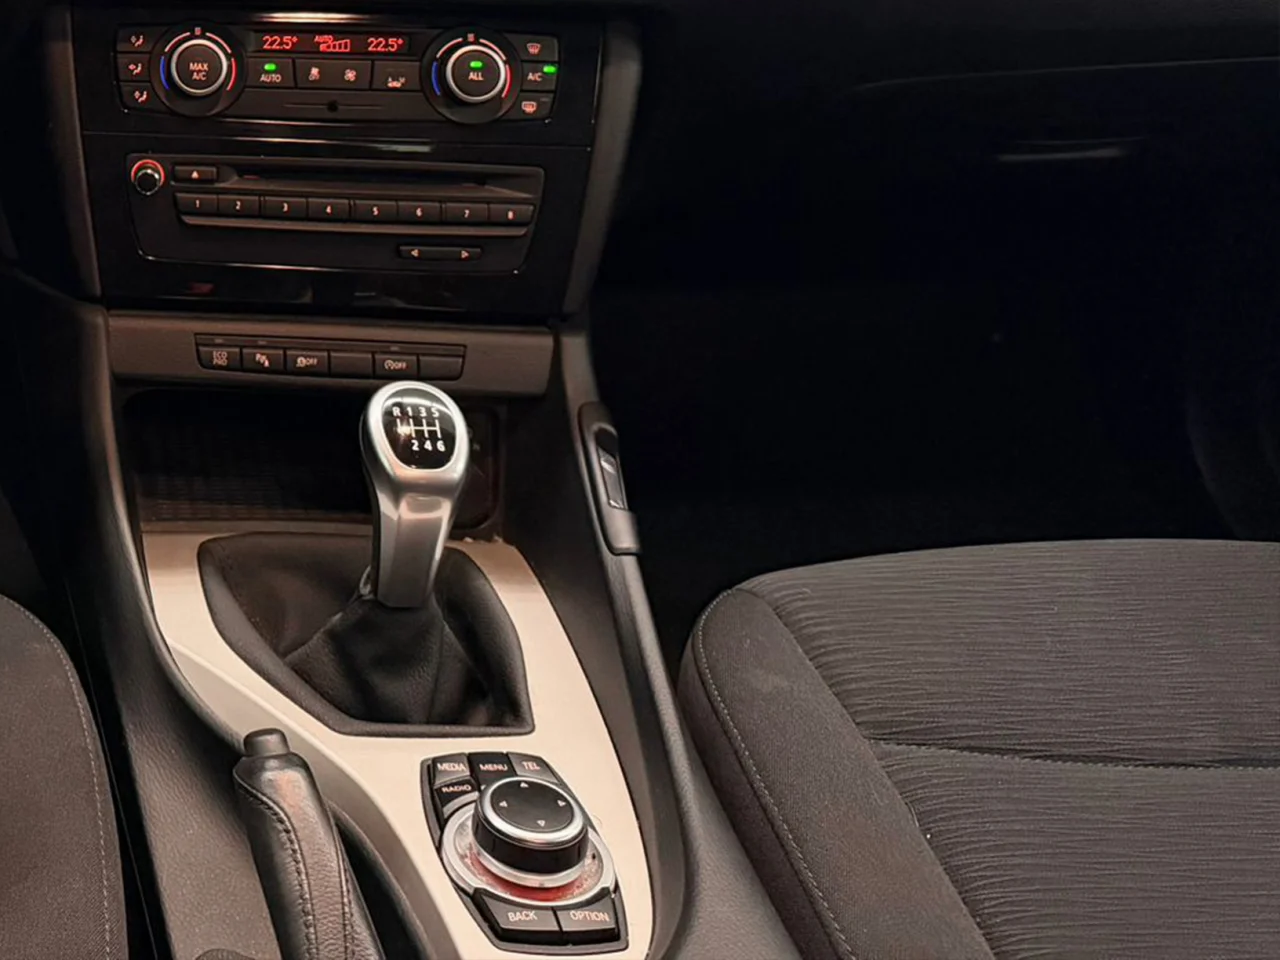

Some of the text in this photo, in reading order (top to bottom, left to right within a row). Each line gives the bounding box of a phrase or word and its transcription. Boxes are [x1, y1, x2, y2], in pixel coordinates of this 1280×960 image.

[189, 62, 209, 71] MAX
[192, 71, 207, 81] A/C
[259, 74, 282, 83] AUTO
[468, 72, 484, 81] ALL
[528, 73, 542, 82] A/C
[195, 200, 200, 208] 1
[235, 201, 241, 210] 2
[282, 203, 288, 212] 3
[325, 205, 332, 214] 4
[372, 207, 379, 216] 5
[416, 208, 422, 217] 6
[464, 209, 470, 218] 7
[394, 361, 407, 370] OFF
[392, 406, 439, 417] R 1 3 5
[411, 440, 446, 452] 2 4 6
[437, 761, 540, 771] MEDIA MENU TEL
[441, 785, 472, 793] RADIO
[508, 910, 609, 921] BACK OPTION
